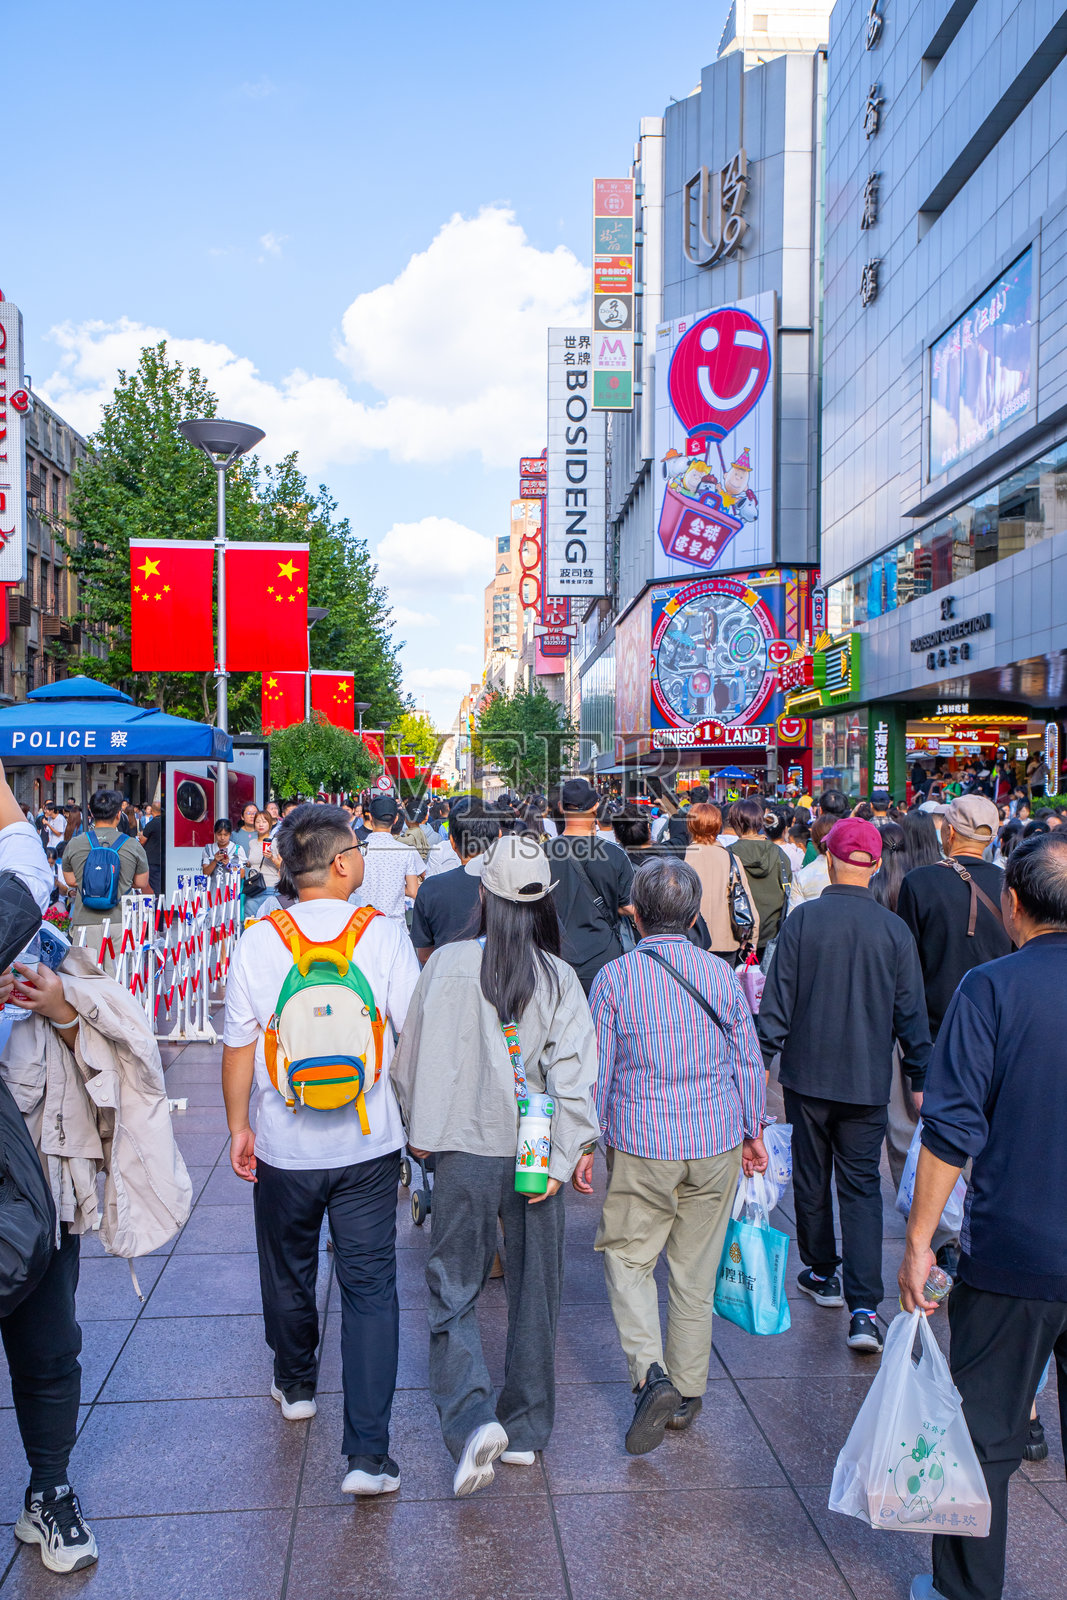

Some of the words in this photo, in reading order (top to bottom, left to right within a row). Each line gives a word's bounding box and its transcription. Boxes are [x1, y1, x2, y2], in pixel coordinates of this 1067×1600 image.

[564, 335, 591, 349] 世界
[564, 352, 591, 366] 名牌
[565, 370, 588, 563] BOSIDENG
[689, 518, 721, 542] 全球
[675, 535, 716, 561] 壹号店
[560, 569, 593, 577] 波司登
[678, 583, 714, 601] MINISO
[718, 582, 743, 593] LAND
[936, 703, 970, 715] 上海好吃城
[12, 731, 96, 748] POLICE
[110, 731, 128, 748] 察
[656, 731, 695, 746] MINISO
[725, 729, 762, 743] LAND
[873, 721, 889, 785] 上海好吃城
